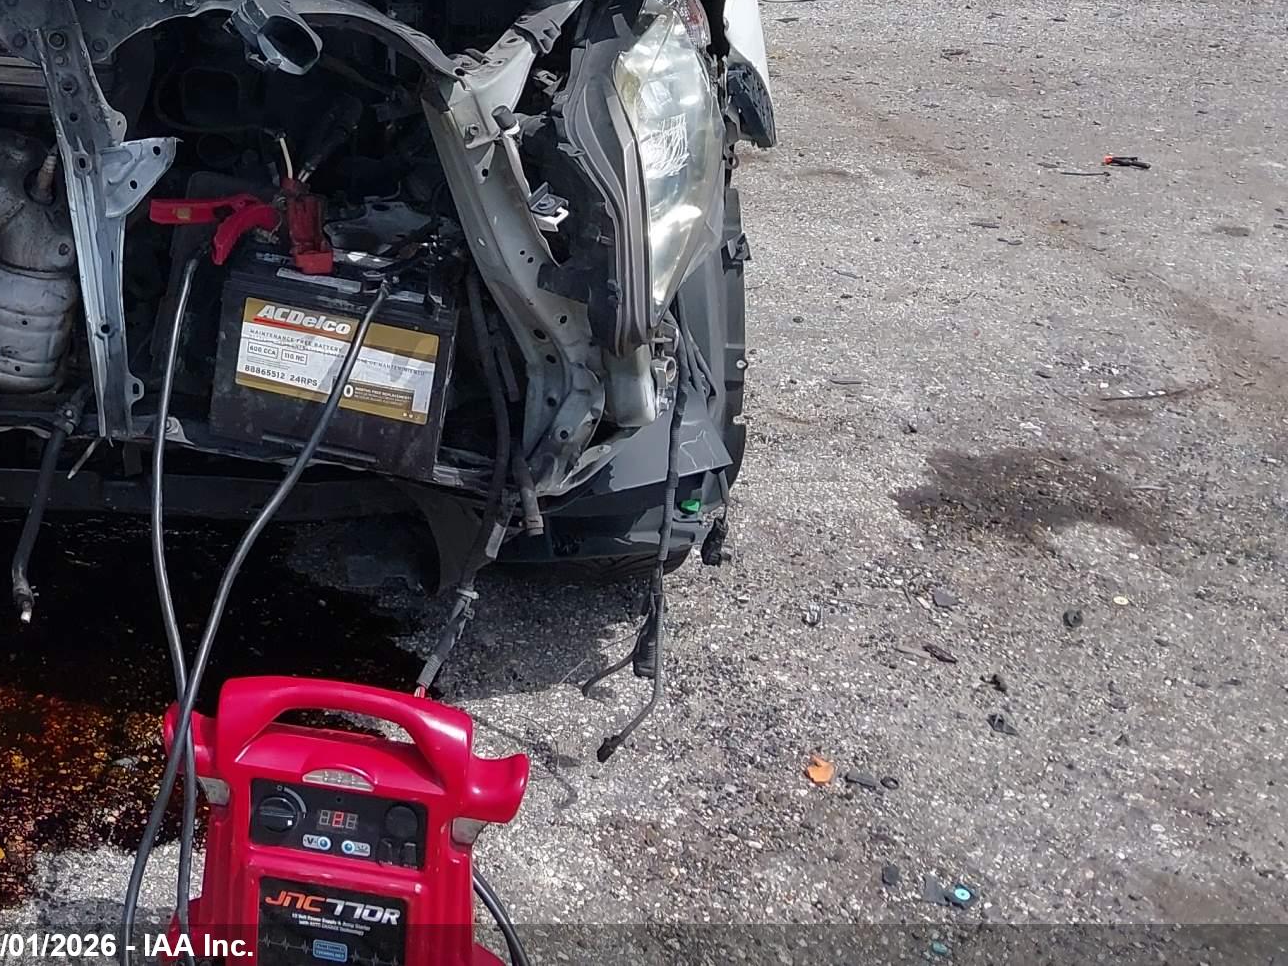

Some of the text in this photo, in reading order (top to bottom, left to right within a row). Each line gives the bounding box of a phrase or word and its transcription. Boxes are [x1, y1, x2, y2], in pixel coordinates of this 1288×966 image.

[257, 304, 352, 335] ACDelco
[244, 364, 318, 387] 88865512 24RPS
